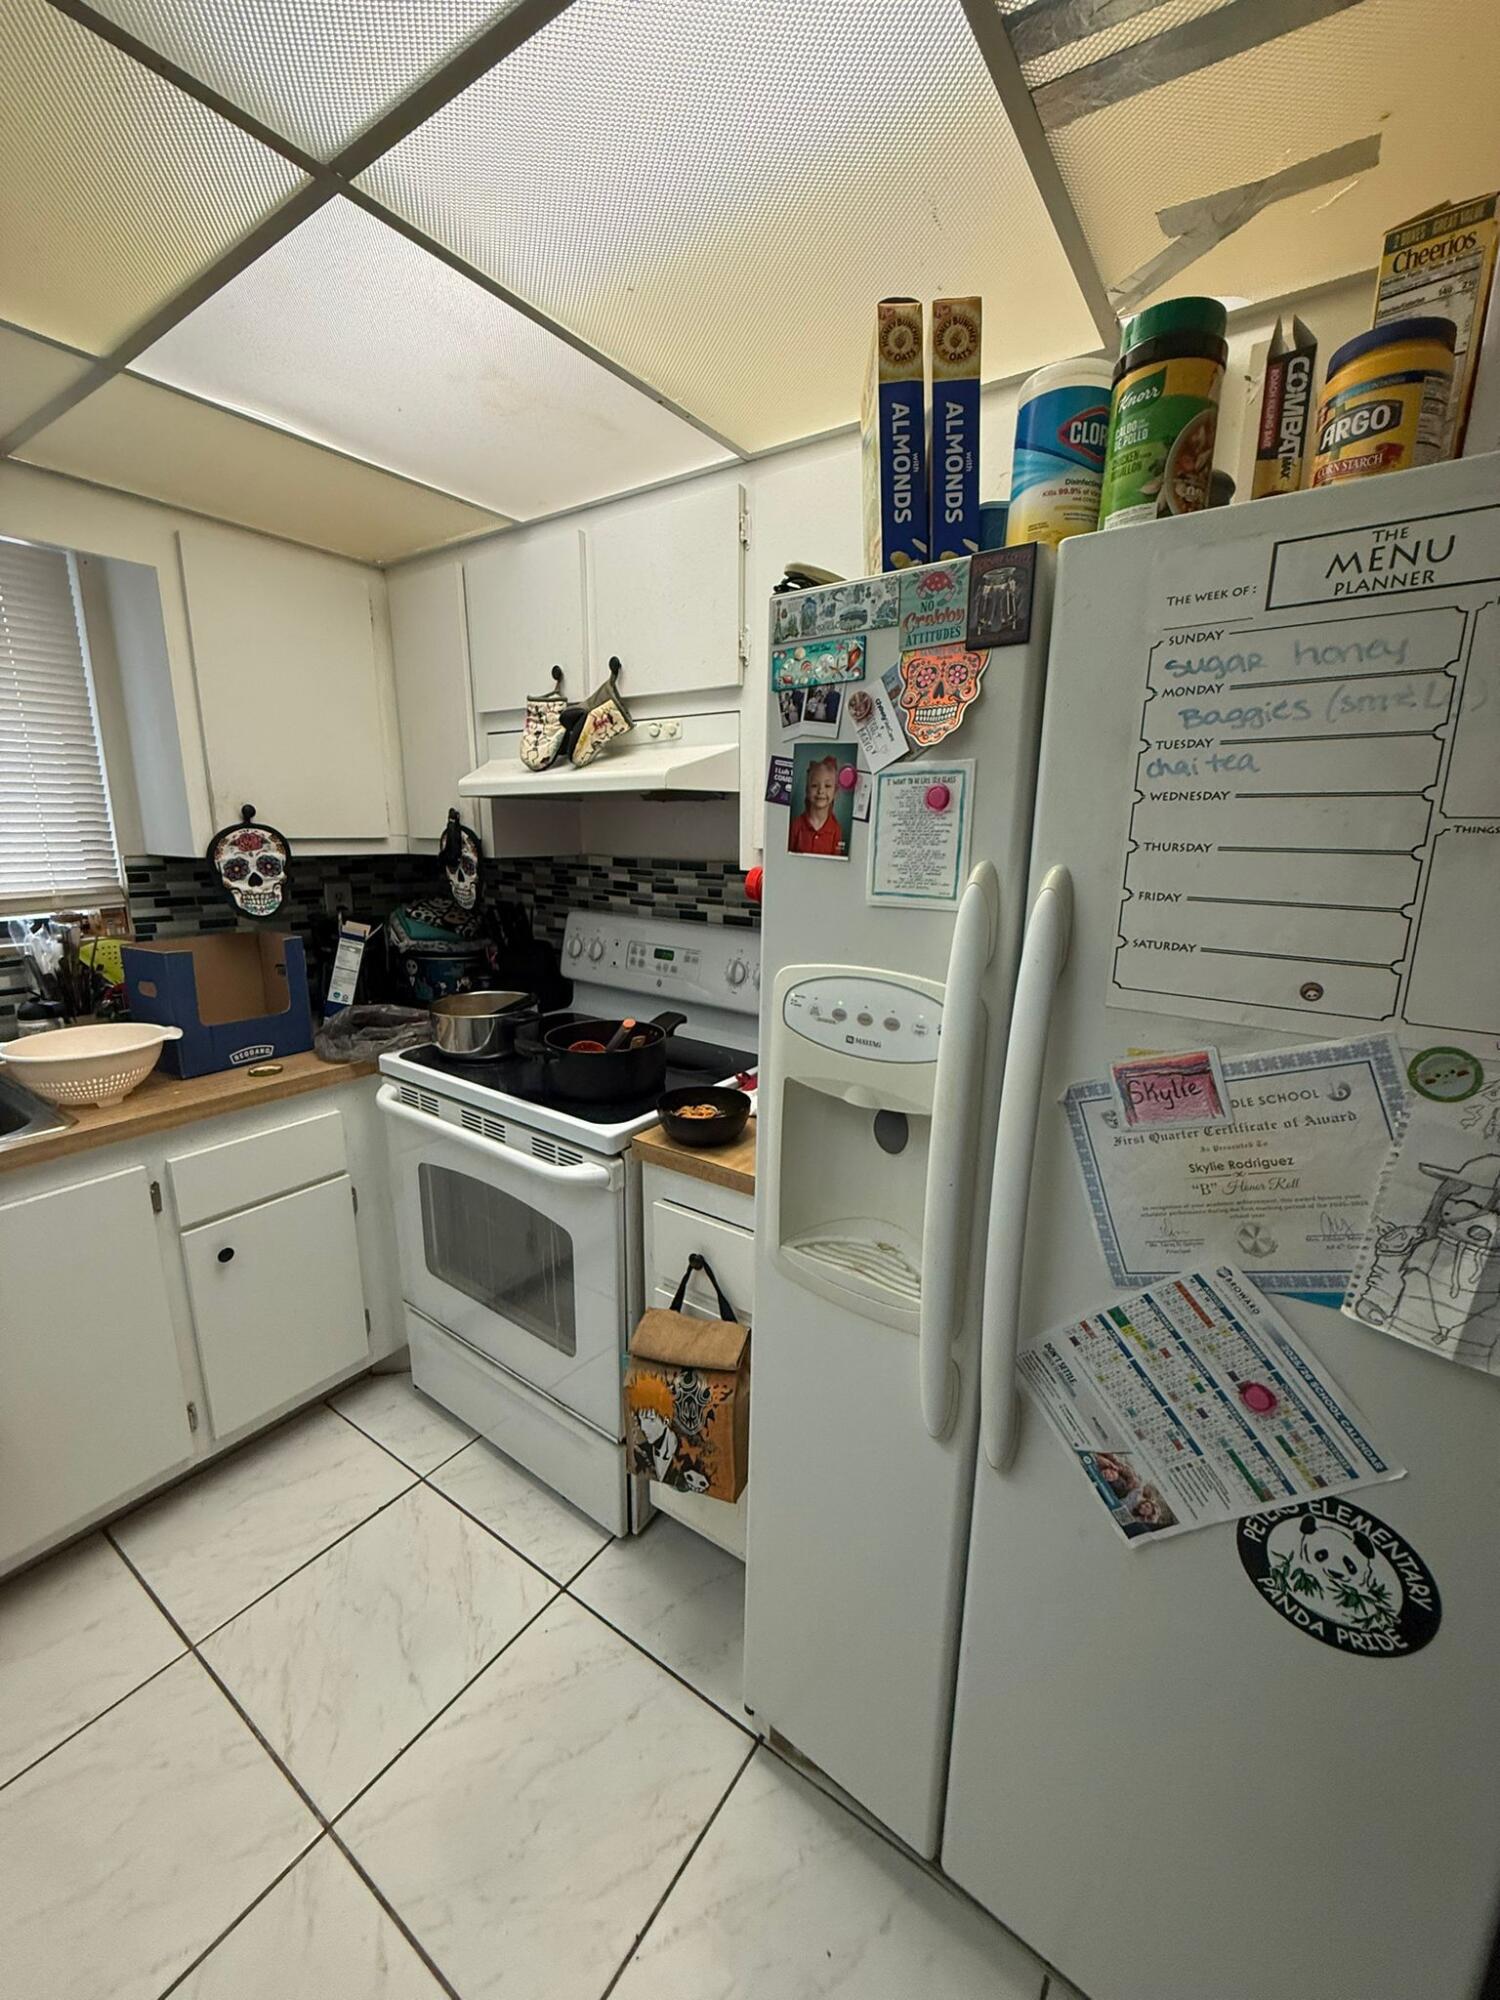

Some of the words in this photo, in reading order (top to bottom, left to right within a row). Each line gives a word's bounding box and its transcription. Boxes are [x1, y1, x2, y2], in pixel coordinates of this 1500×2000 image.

[1392, 231, 1477, 273] Cheerios
[1118, 386, 1161, 413] Knorr
[1278, 356, 1310, 459] COMBAT
[1124, 427, 1149, 447] POLLO
[1320, 404, 1391, 450] ARGO
[891, 402, 912, 524] ALMONDS
[945, 402, 964, 524] ALMONDS
[1342, 453, 1384, 471] STARCH
[1372, 526, 1411, 543] THE
[1324, 535, 1457, 579] MENU
[1334, 570, 1436, 596] PLANNER
[920, 600, 935, 613] NO
[1167, 595, 1192, 606] THE
[1195, 589, 1229, 602] WEEK
[902, 606, 965, 633] Crabby
[905, 626, 961, 647] ATTITUDES
[1168, 629, 1225, 646] SUNDAY
[1293, 636, 1409, 666] honey
[1161, 683, 1225, 699] MONDAY
[1178, 699, 1312, 730] Baggies
[1155, 738, 1215, 750] TUESDAY
[1146, 757, 1199, 778] chai
[1205, 752, 1261, 773] tea
[1149, 790, 1232, 801] WEDNESDAY
[1143, 840, 1213, 854] THURSDAY
[1137, 891, 1183, 903] FRIDAY
[1132, 937, 1197, 953] SATURDAY
[1258, 1089, 1320, 1106] SCHOOL
[1113, 1134, 1145, 1147] First
[1149, 1129, 1199, 1145] Quarter
[1204, 1121, 1278, 1137] Certificate
[1284, 1116, 1298, 1129] of
[1304, 1110, 1358, 1127] Award
[1188, 1161, 1225, 1174] Skylie
[1228, 1157, 1294, 1170] Rodriguez
[1310, 1380, 1342, 1419] SCHOOL
[1341, 1419, 1383, 1470] CALENDAR
[1308, 1500, 1433, 1611] ELEMENTARY
[1257, 1576, 1324, 1637] PANDA
[1336, 1627, 1409, 1652] PRIDE
